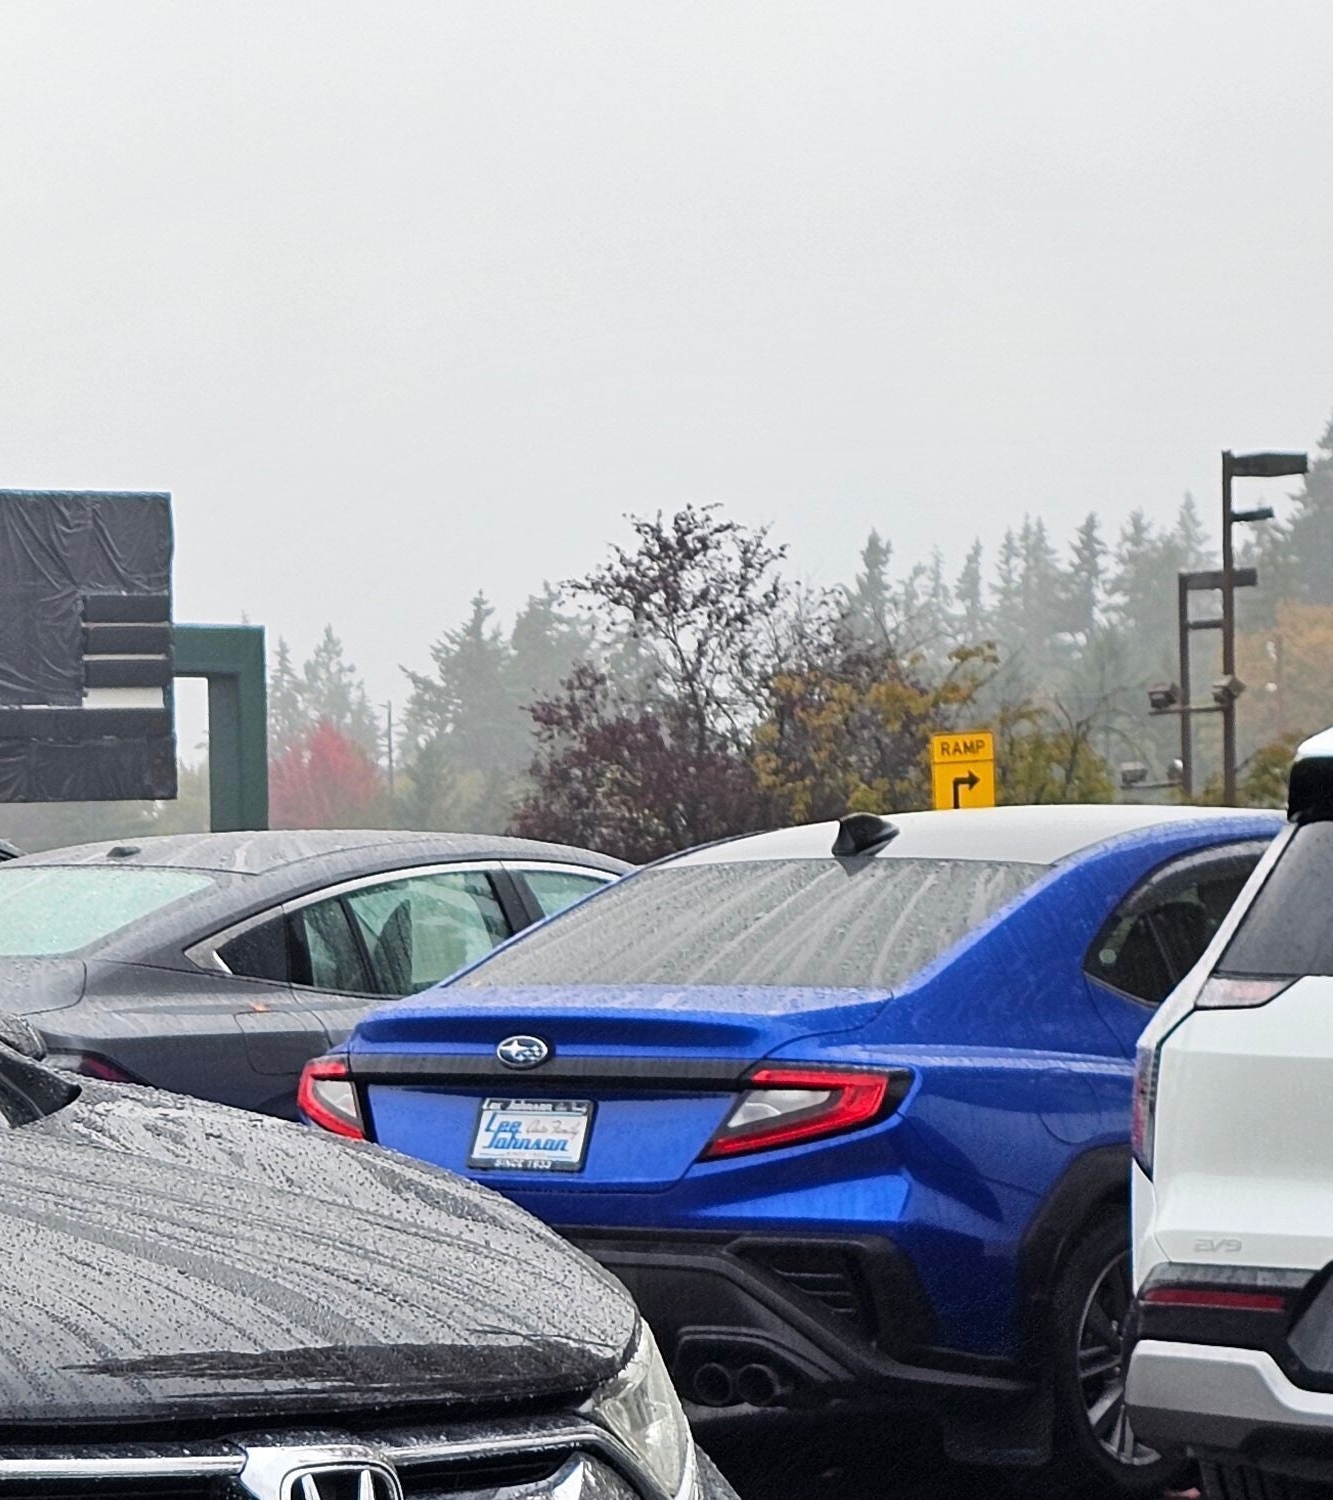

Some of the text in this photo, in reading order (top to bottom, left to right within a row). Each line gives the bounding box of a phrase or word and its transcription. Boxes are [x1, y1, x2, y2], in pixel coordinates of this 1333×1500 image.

[940, 740, 985, 756] RAMP
[484, 1112, 522, 1133] Lee
[482, 1129, 569, 1152] Johnson
